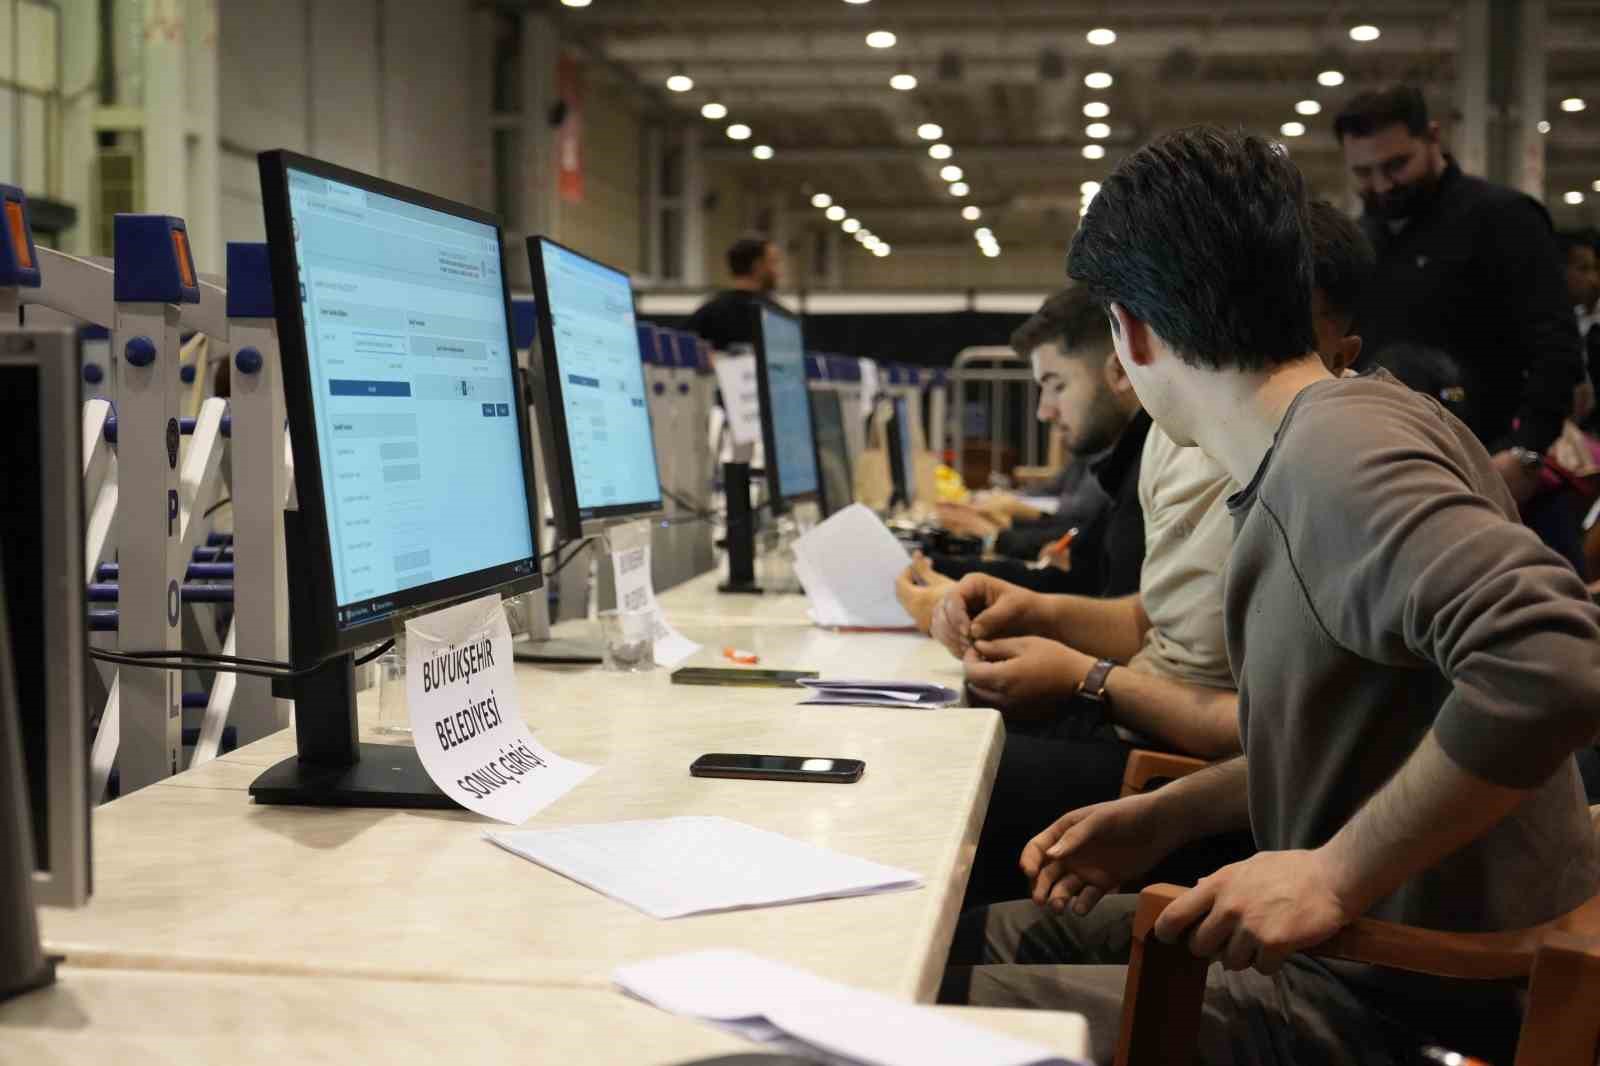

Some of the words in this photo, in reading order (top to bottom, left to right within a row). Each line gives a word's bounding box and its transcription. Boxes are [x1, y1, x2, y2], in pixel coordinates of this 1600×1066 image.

[423, 634, 495, 693] BÜYÜKŞEHİR
[435, 688, 502, 751] BELEDİYESİ
[457, 763, 520, 799] SONUÇ
[498, 739, 547, 775] GİRİŞİ
